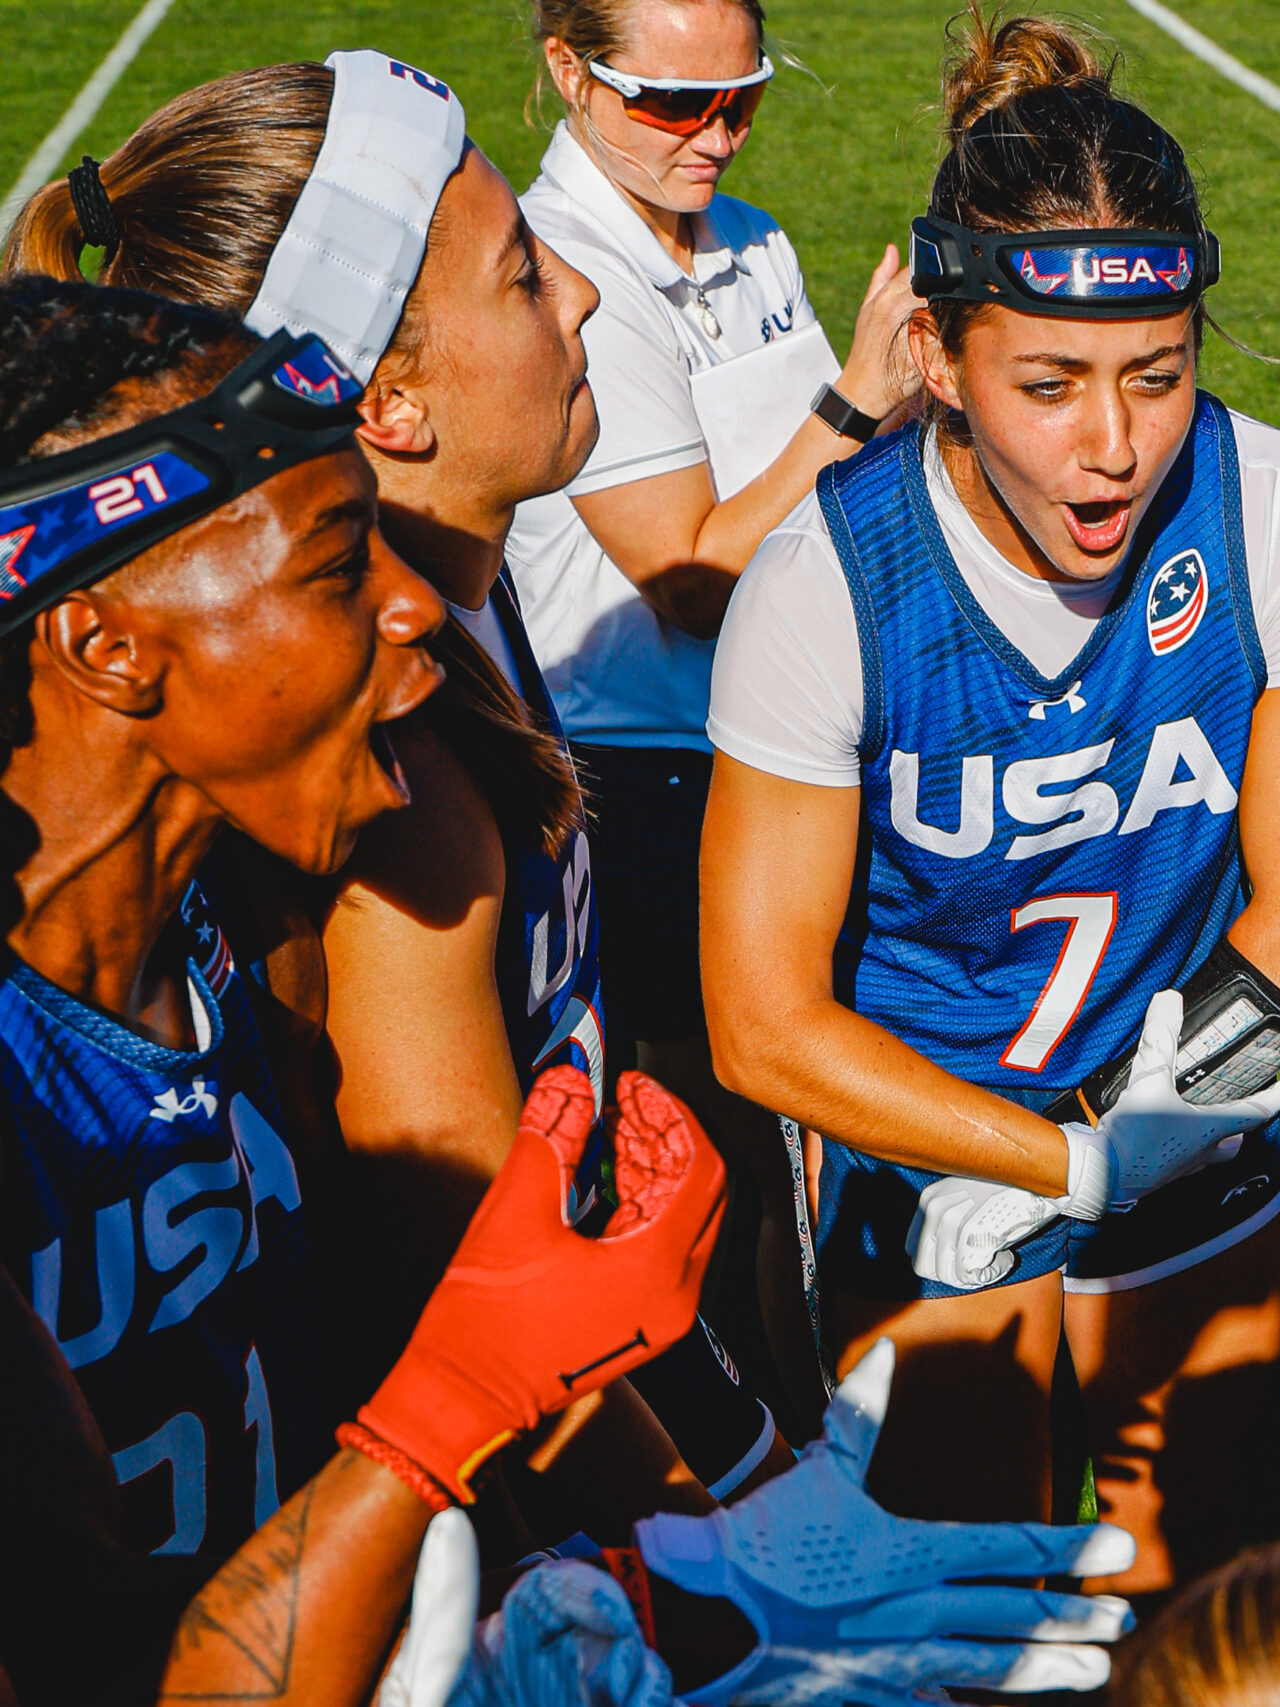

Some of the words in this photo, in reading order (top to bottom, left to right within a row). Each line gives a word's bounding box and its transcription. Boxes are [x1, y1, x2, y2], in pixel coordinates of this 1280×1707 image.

[1071, 256, 1159, 285] USA
[88, 462, 168, 525] 21
[888, 716, 1240, 861] USA
[998, 890, 1120, 1074] 7
[30, 1090, 302, 1371] USA
